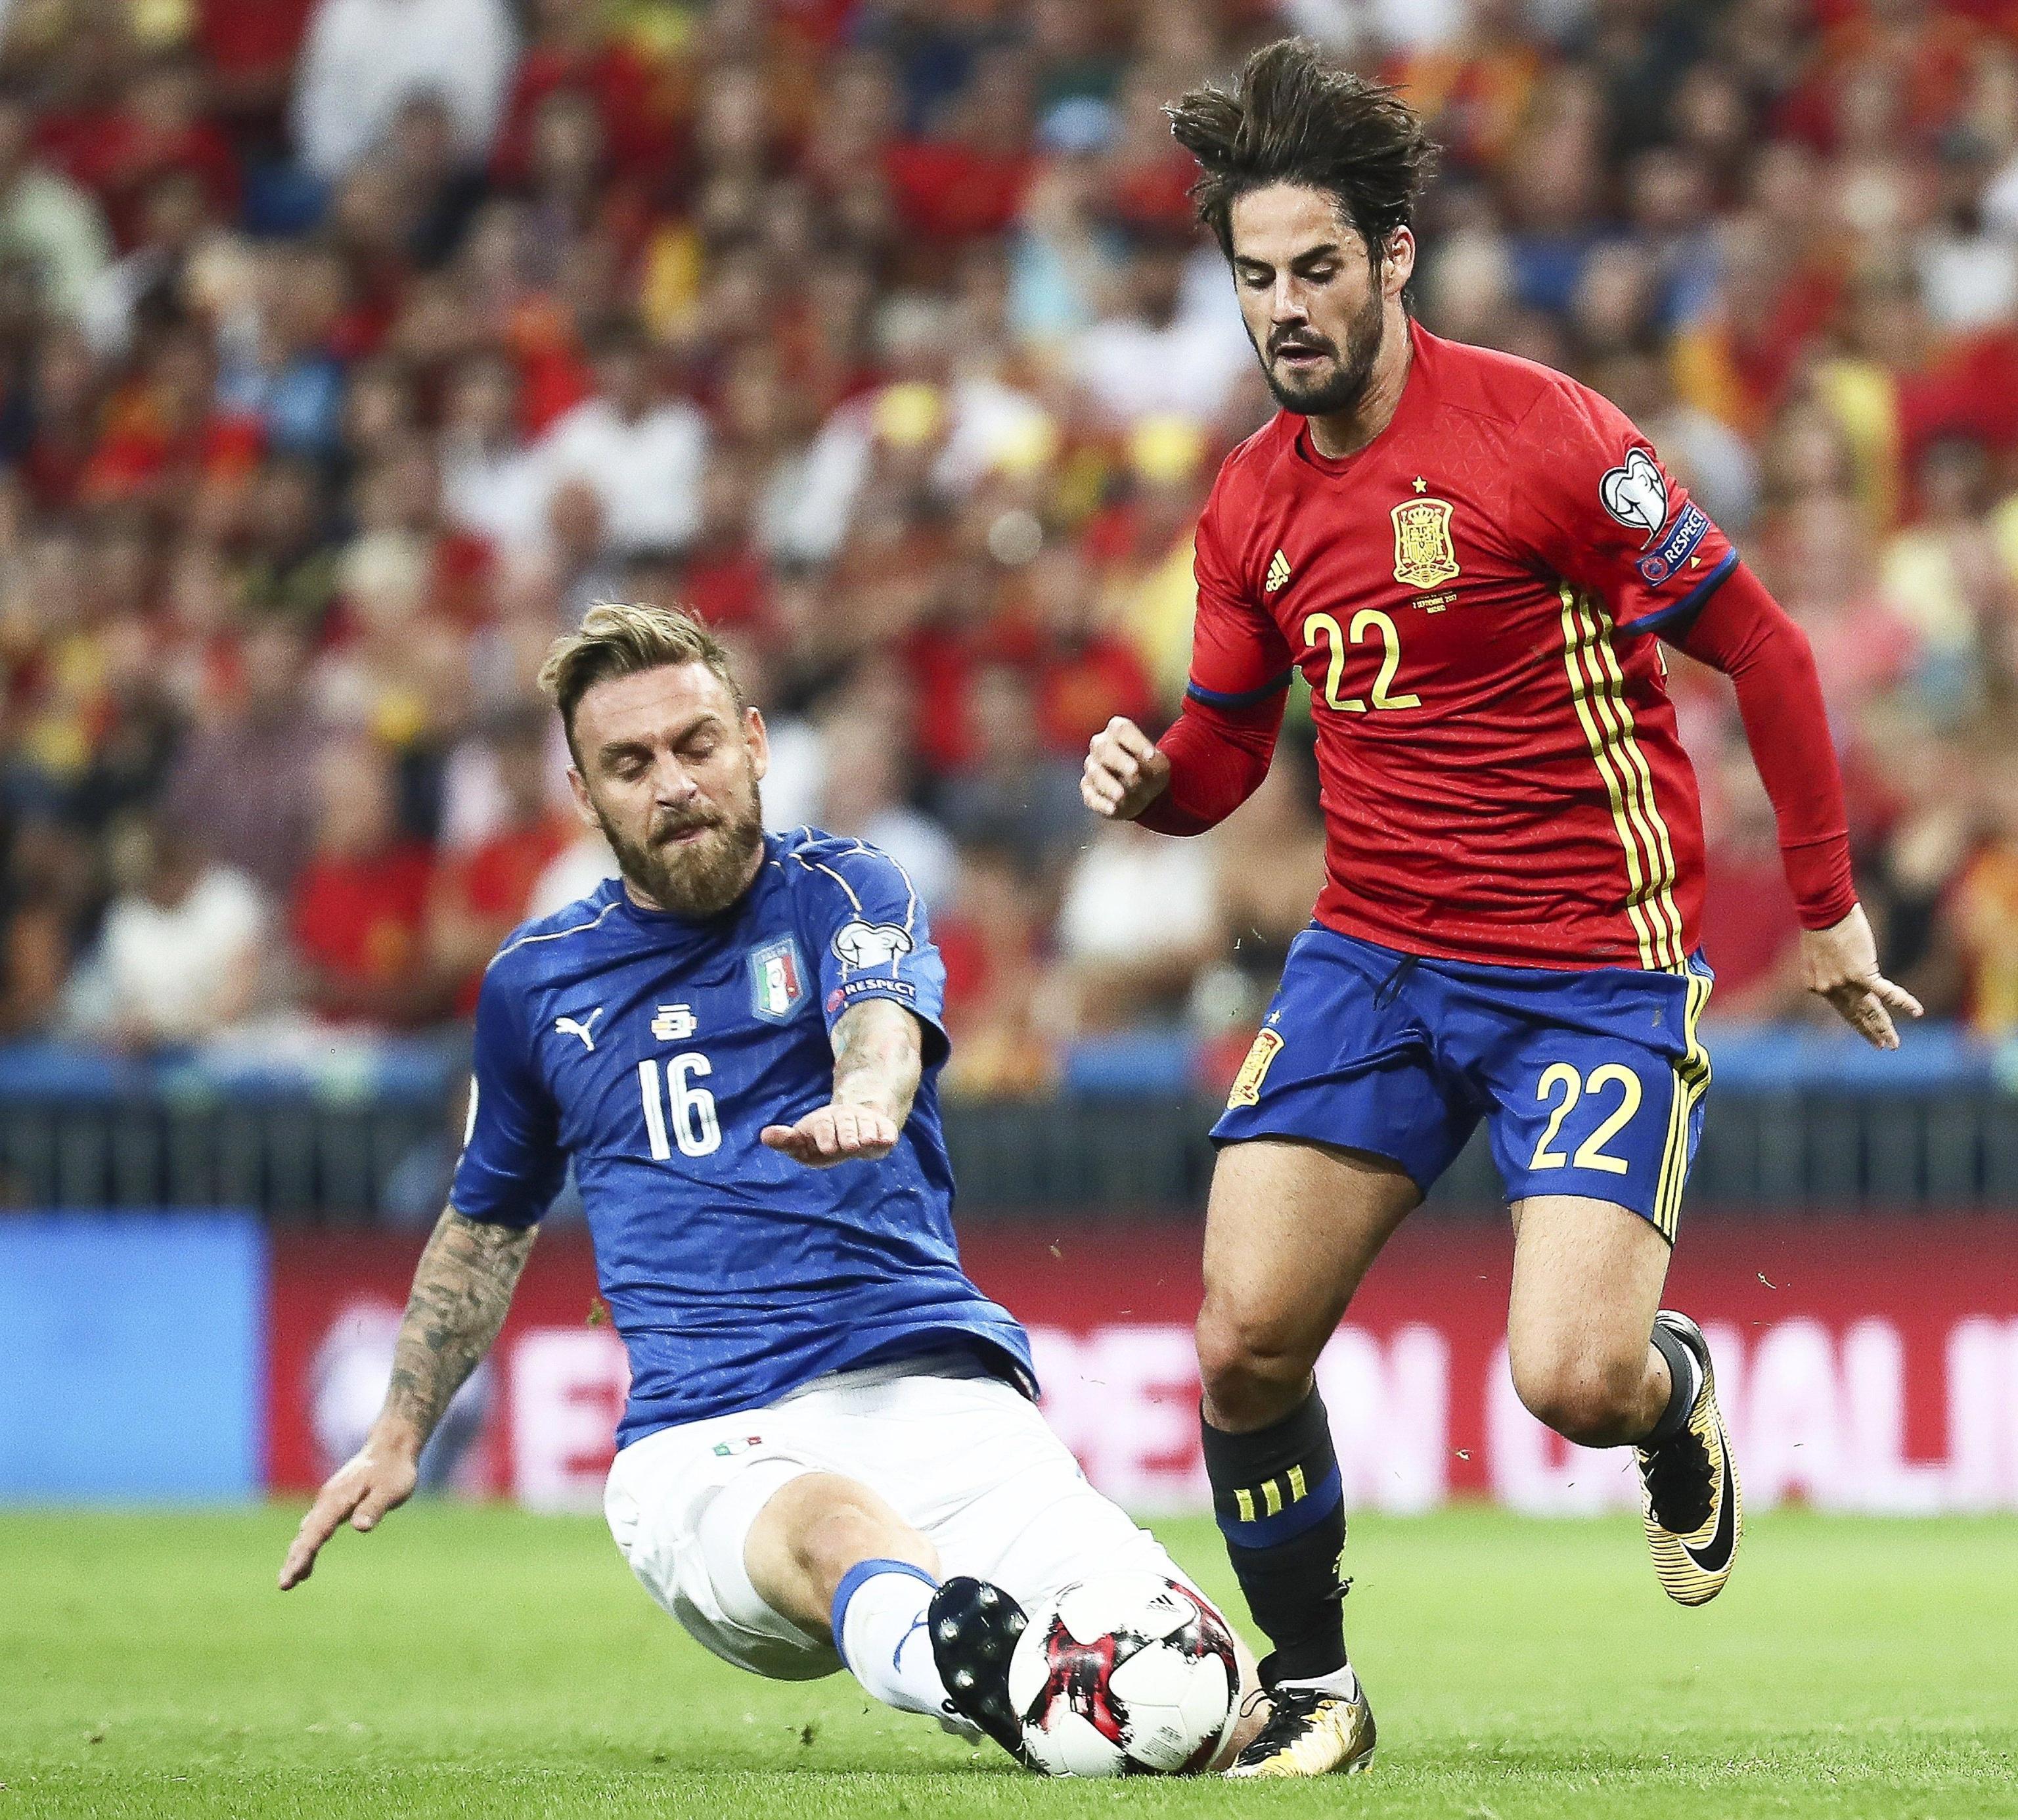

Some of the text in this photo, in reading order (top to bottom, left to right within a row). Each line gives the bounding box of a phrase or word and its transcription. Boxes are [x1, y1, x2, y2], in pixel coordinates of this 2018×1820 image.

[1664, 507, 1704, 564] RESPECT
[1303, 608, 1422, 712] 22
[845, 978, 916, 997] RESPECT
[638, 1052, 722, 1161] 16
[1528, 1062, 1642, 1175] 22
